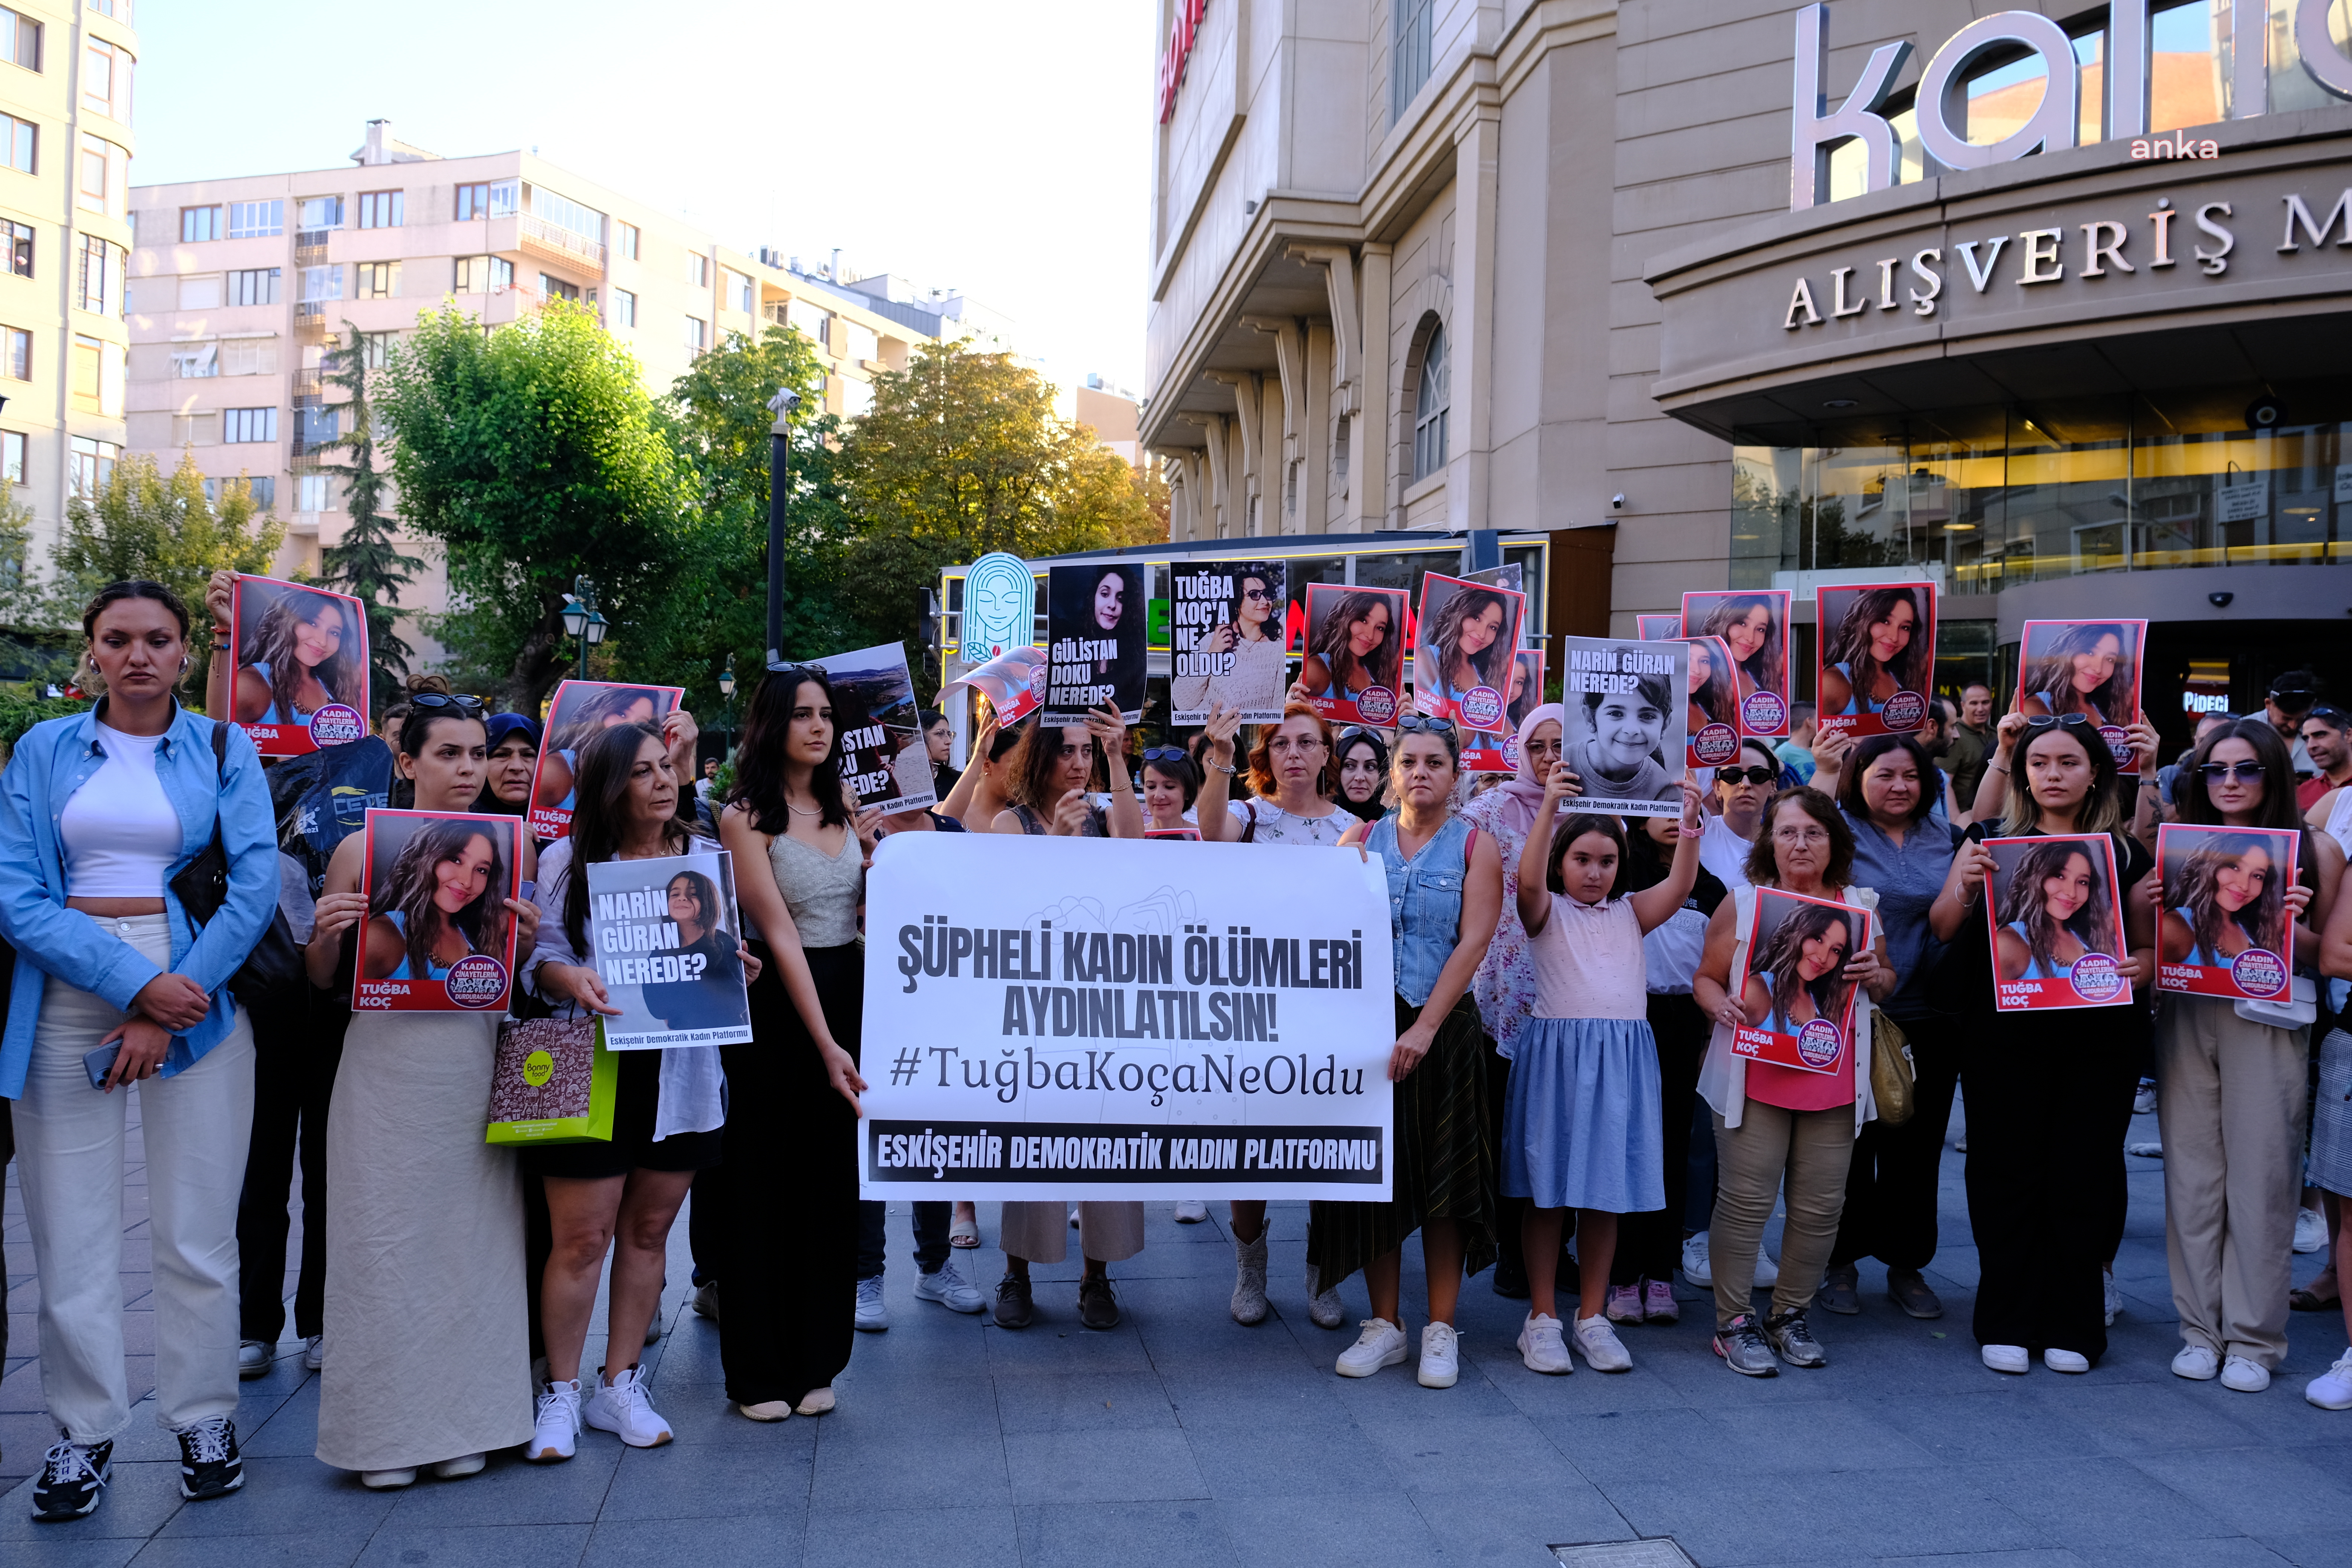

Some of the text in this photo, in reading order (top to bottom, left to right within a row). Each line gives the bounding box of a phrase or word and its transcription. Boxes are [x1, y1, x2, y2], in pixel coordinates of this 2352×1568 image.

[1782, 196, 2235, 331] ALIŞVERİŞ
[1175, 570, 1234, 599] TUĞBA
[1176, 601, 1230, 632] KOÇ'A
[1176, 628, 1199, 651] NE
[1052, 637, 1118, 663] GÜLİSTAN
[1176, 652, 1236, 677] OLDU?
[1571, 648, 1675, 675] NARİN GÜRAN
[1051, 663, 1091, 685] DOKU
[1570, 672, 1639, 695] NEREDE?
[1049, 684, 1115, 706] NEREDE?
[1417, 690, 1441, 707] TUĞBA
[1468, 696, 1498, 704] CİNAYETLERİNİ
[1473, 690, 1495, 699] KADIN
[998, 699, 1021, 714] TUĞBA
[1308, 698, 1335, 709] UĞBA
[1418, 700, 1433, 714] KOÇ
[317, 717, 355, 725] CİNAYETLERİNİ
[1003, 713, 1016, 723] KOÇ
[1175, 713, 1201, 723] Eskişehir
[1821, 717, 1857, 727] TUĞBA
[244, 726, 279, 739] UĞBA
[1459, 750, 1481, 760] UĞBA
[1459, 761, 1471, 770] OÇ
[887, 801, 903, 810] Kadın
[904, 795, 933, 805] Platformu
[1563, 799, 1680, 813] Eskişehir Demokratik Kadın Platformu
[533, 822, 559, 837] KOÇ
[599, 886, 669, 920] NARİN
[602, 920, 680, 952] GÜRAN
[898, 915, 1362, 994] ŞÜPHELİ KADIN ÖLÜMLERİ
[2243, 954, 2274, 963] KADIN
[461, 963, 495, 972] KADIN
[606, 952, 707, 985] NEREDE?
[2081, 959, 2110, 968] KADIN
[2239, 961, 2278, 971] CİNAYETLERİNİ
[455, 969, 499, 978] CİNAYETLERİNİ
[2161, 966, 2203, 979] TUĞBA
[360, 982, 411, 995] TUĞBA
[2000, 982, 2043, 994] TUĞBA
[2162, 977, 2188, 991] KOÇ
[359, 997, 392, 1009] KOÇ
[2002, 995, 2029, 1008] KOÇ
[1003, 985, 1279, 1042] AYDINLATILSIN!
[1809, 1023, 1833, 1034] KADIN
[610, 1029, 748, 1047] Eskişehir Demokratik Kadın Platformu
[1738, 1029, 1773, 1046] TUĞBA
[1736, 1041, 1760, 1057] KOÇ
[527, 1063, 550, 1073] Bonny
[890, 1046, 1364, 1107] #TuğbaKoçaNeOldu
[877, 1128, 1377, 1179] ESKİŞEHİR DEMOKRATİK KADIN PLATFORMU
